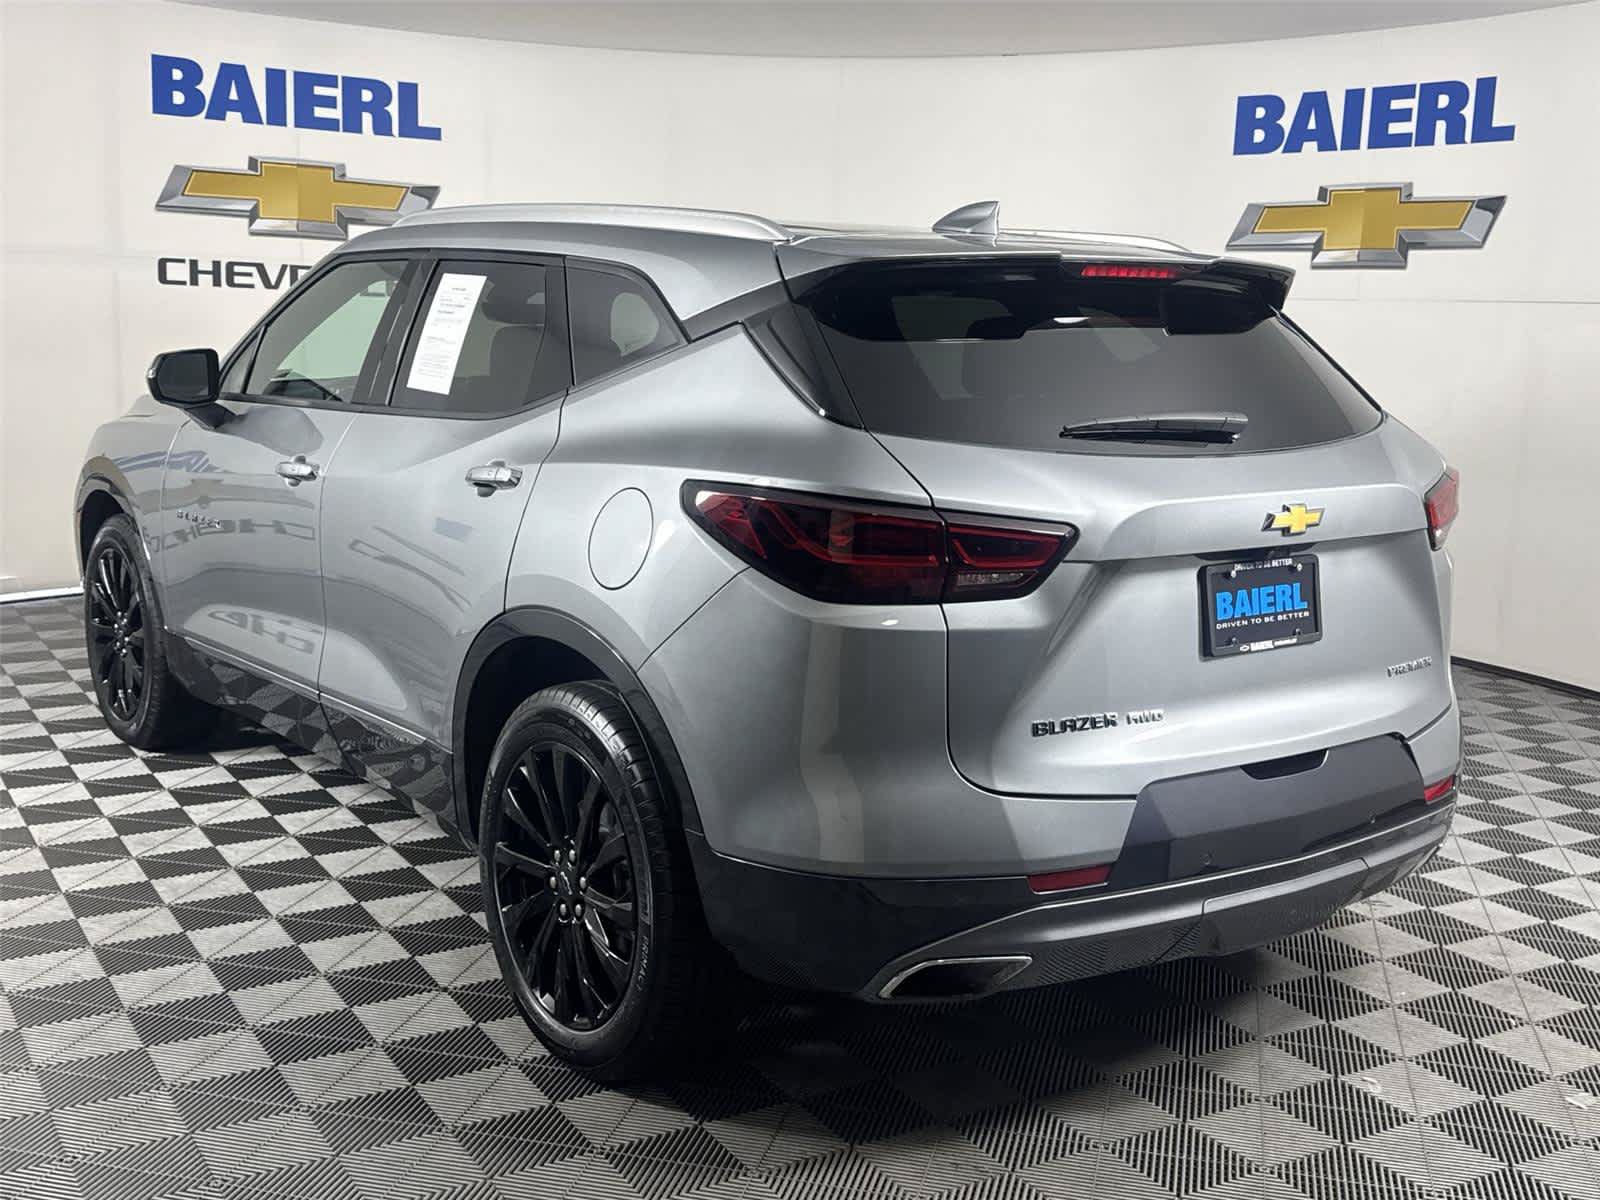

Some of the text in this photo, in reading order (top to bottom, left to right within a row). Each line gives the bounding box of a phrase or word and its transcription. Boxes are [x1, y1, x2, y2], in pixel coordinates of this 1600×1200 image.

[151, 54, 442, 141] BAIERL
[1233, 76, 1516, 156] BAIERL
[1272, 558, 1292, 567] BETTER
[1216, 583, 1308, 620] BAIERL
[1216, 620, 1248, 630] DRIVEN
[1264, 615, 1275, 623] BE
[1277, 611, 1310, 621] BETTER
[1031, 711, 1118, 737] BLAZER
